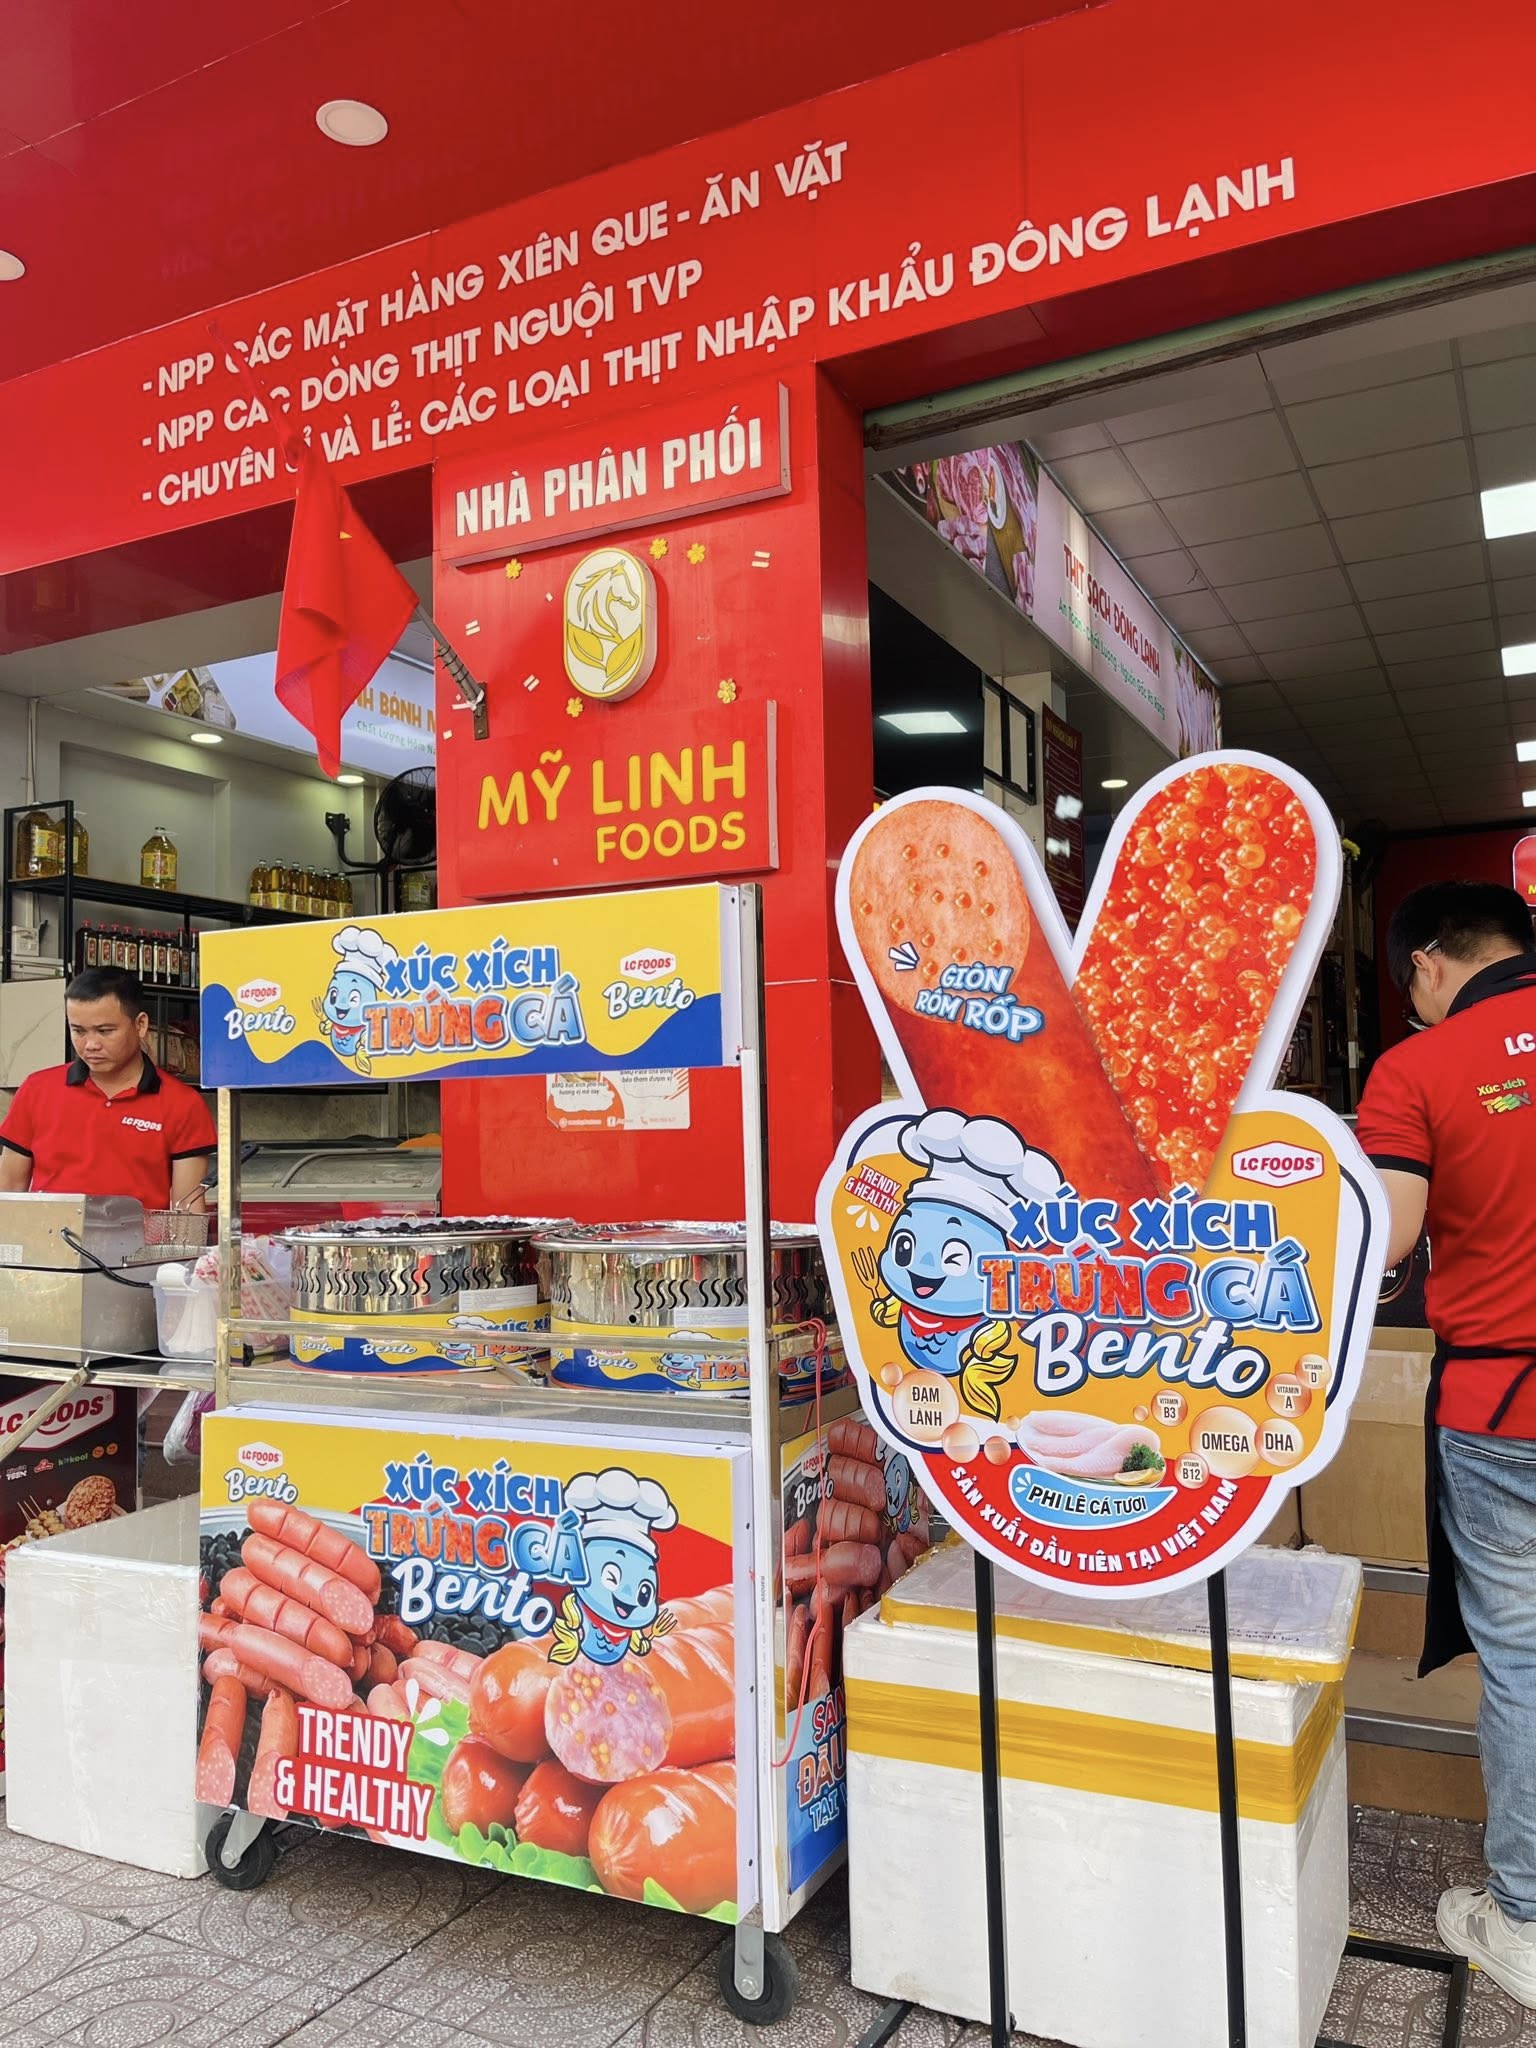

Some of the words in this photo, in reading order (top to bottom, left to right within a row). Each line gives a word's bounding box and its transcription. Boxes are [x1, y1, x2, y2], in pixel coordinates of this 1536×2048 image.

[303, 299, 369, 354] MẶT
[380, 271, 484, 328] HÀNG
[498, 231, 579, 291] XIÊN
[592, 201, 669, 257] QUE
[700, 171, 759, 225] ĂN
[775, 138, 849, 200] VẶT
[320, 413, 360, 463] VÀ
[372, 399, 412, 452] LẺ:
[420, 380, 497, 435] CÁC
[507, 359, 591, 415] LOẠI
[604, 333, 682, 386] THỊT
[697, 298, 815, 362] NHẬP
[828, 240, 954, 326] KHẨU
[969, 219, 1128, 286] ĐÔNG
[1145, 156, 1295, 238] LẠNH
[302, 355, 399, 412] DÒNG
[412, 327, 482, 381] THỊT
[494, 280, 614, 343] NGUỘI
[627, 258, 703, 313] TVP
[455, 469, 531, 537] NHÀ
[544, 446, 647, 518] PHÂN
[662, 405, 763, 490] PHỐI
[1063, 543, 1085, 597] THỊT
[1087, 573, 1112, 625] SẠCH
[1113, 602, 1139, 655] ĐÔNG
[1140, 632, 1160, 679] LẠNH
[380, 690, 422, 728] BÁNH
[478, 748, 571, 830] MỸ
[592, 740, 746, 815] LINH
[596, 811, 746, 864] FOODS
[384, 943, 456, 996] XÚC
[466, 937, 557, 990] XÍCH
[624, 960, 636, 971] LC
[637, 957, 672, 970] FOODS
[240, 989, 251, 999] LC
[251, 986, 277, 998] FOODS
[364, 988, 506, 1049] TRỨNG
[511, 974, 583, 1043] CÁ
[602, 977, 696, 1019] Bento
[224, 1005, 296, 1040] Bento
[963, 993, 1044, 1042] RỐP
[1504, 1032, 1536, 1056] LC
[1477, 1084, 1500, 1096] Xúc
[133, 1118, 162, 1131] FOODS
[860, 1165, 901, 1197] TRENDY
[1240, 1158, 1259, 1171] LC
[1261, 1157, 1315, 1171] FOODS
[845, 1176, 856, 1191] &
[854, 1182, 901, 1215] HEALTHY
[1011, 1183, 1119, 1248] XÚC
[1134, 1183, 1276, 1250] XÍCH
[980, 1241, 1194, 1320] TRỨNG
[1201, 1240, 1318, 1330] CÁ
[360, 1343, 417, 1355] Bento
[587, 1354, 638, 1370] Bento
[1022, 1313, 1270, 1397] Bento
[912, 1386, 940, 1405] ĐẠM
[1310, 1372, 1317, 1383] D
[910, 1407, 942, 1426] LÀNH
[1163, 1406, 1176, 1418] B3
[1285, 1396, 1293, 1409] A
[242, 1450, 252, 1460] LC
[252, 1451, 280, 1463] FOODS
[1201, 1432, 1250, 1452] OMEGA
[1265, 1432, 1294, 1452] DHA
[224, 1467, 298, 1504] Bento
[385, 1452, 457, 1503] XÚC
[466, 1458, 562, 1517] XÍCH
[1182, 1468, 1201, 1481] B12
[793, 1471, 834, 1518] Bento
[1028, 1486, 1062, 1509] PHI
[1065, 1494, 1086, 1513] LÊ
[1090, 1496, 1111, 1515] CÁ
[1114, 1496, 1147, 1514] TƯƠI
[951, 1466, 984, 1507] SẢN
[980, 1503, 1029, 1548] XUẤT
[1029, 1535, 1072, 1567] ĐẦU
[1077, 1549, 1124, 1572] TIÊN
[1126, 1545, 1163, 1570] TẠI
[1161, 1518, 1206, 1557] VIỆT
[1200, 1478, 1239, 1526] NAM
[364, 1502, 508, 1568] TRỨNG
[511, 1514, 589, 1586] CÁ
[391, 1557, 556, 1638] Bento
[298, 1706, 412, 1771] TRENDY
[276, 1760, 296, 1805] &
[304, 1764, 433, 1837] HEALTHY
[810, 1788, 840, 1832] TẠI
